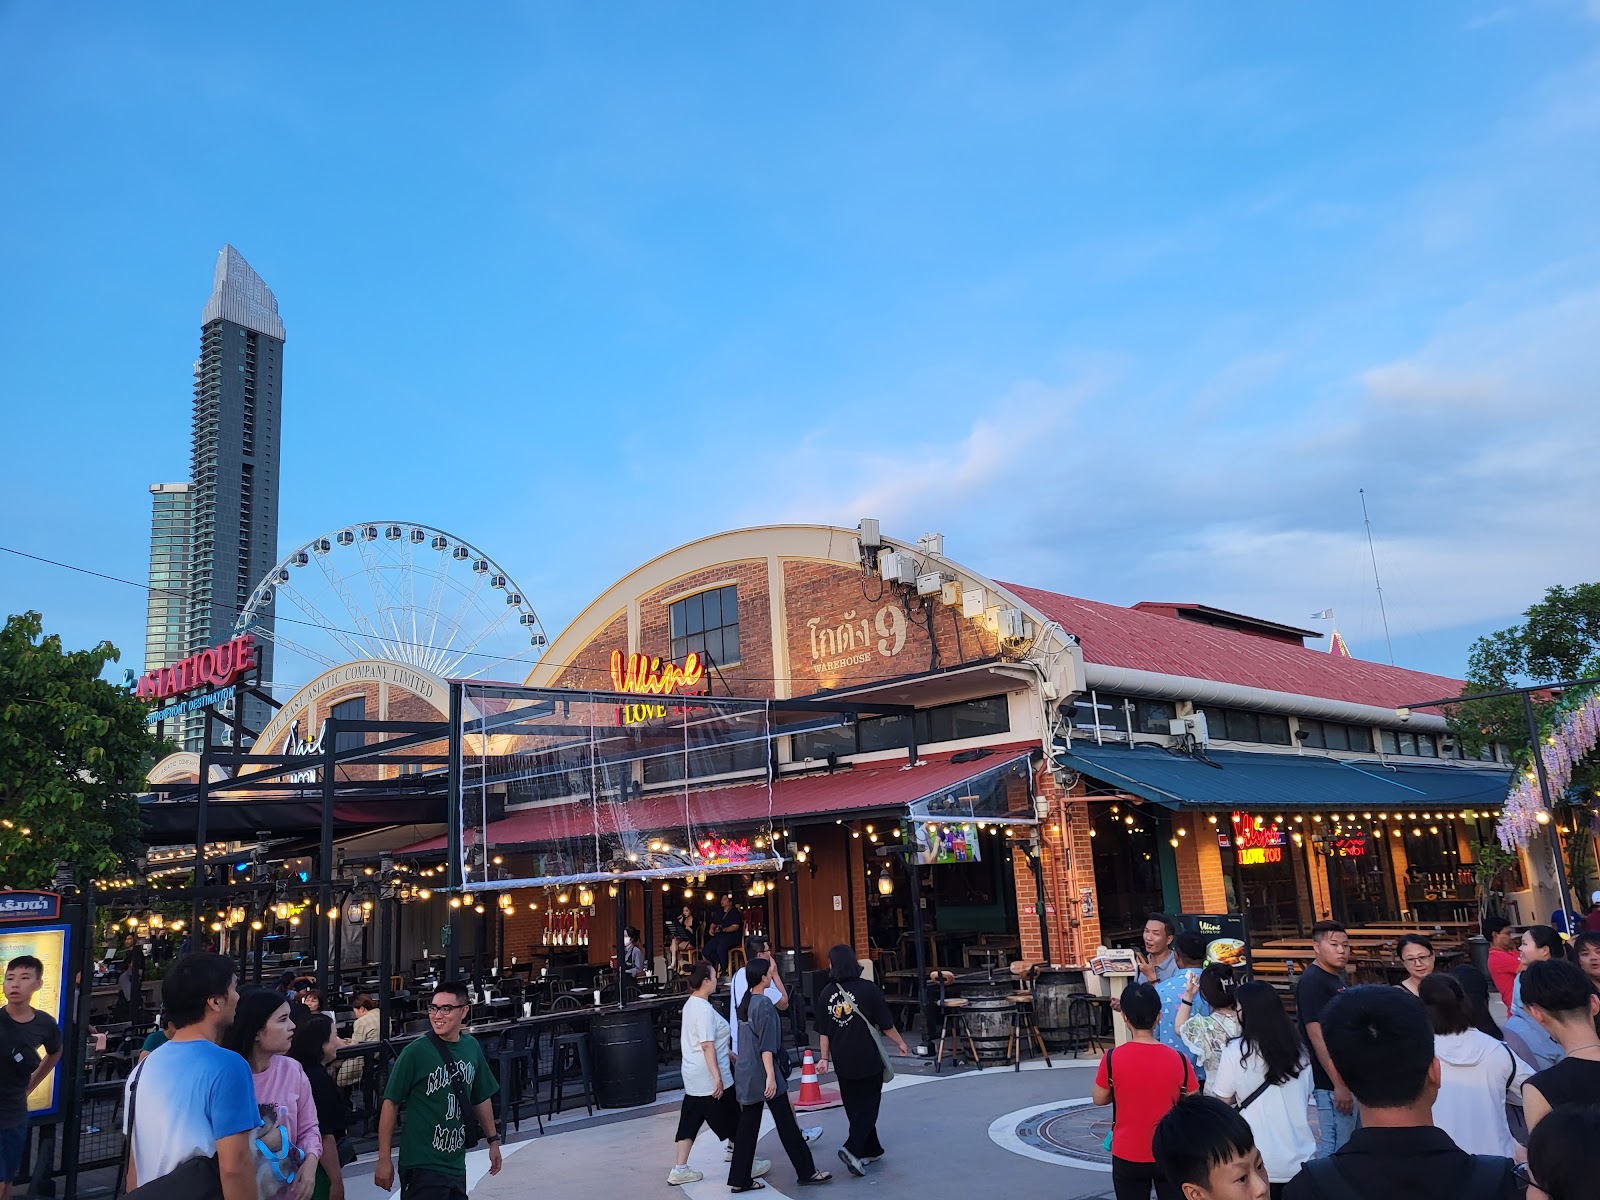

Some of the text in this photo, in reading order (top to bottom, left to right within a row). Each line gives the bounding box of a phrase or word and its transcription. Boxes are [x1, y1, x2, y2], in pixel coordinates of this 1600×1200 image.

[807, 605, 906, 659] โกดัง 9
[135, 634, 255, 698] ASIATIQUE
[610, 649, 705, 695] Wine
[813, 653, 871, 673] WAREHOUSE
[188, 686, 236, 712] DESTINATION
[266, 665, 433, 742] THE EAST ASIATIC COMPANY LIMITED
[625, 704, 667, 725] LOVE
[282, 719, 326, 756] Sail
[1242, 848, 1266, 865] LOVE
[1264, 847, 1281, 863] YOU
[426, 1060, 476, 1096] MASO
